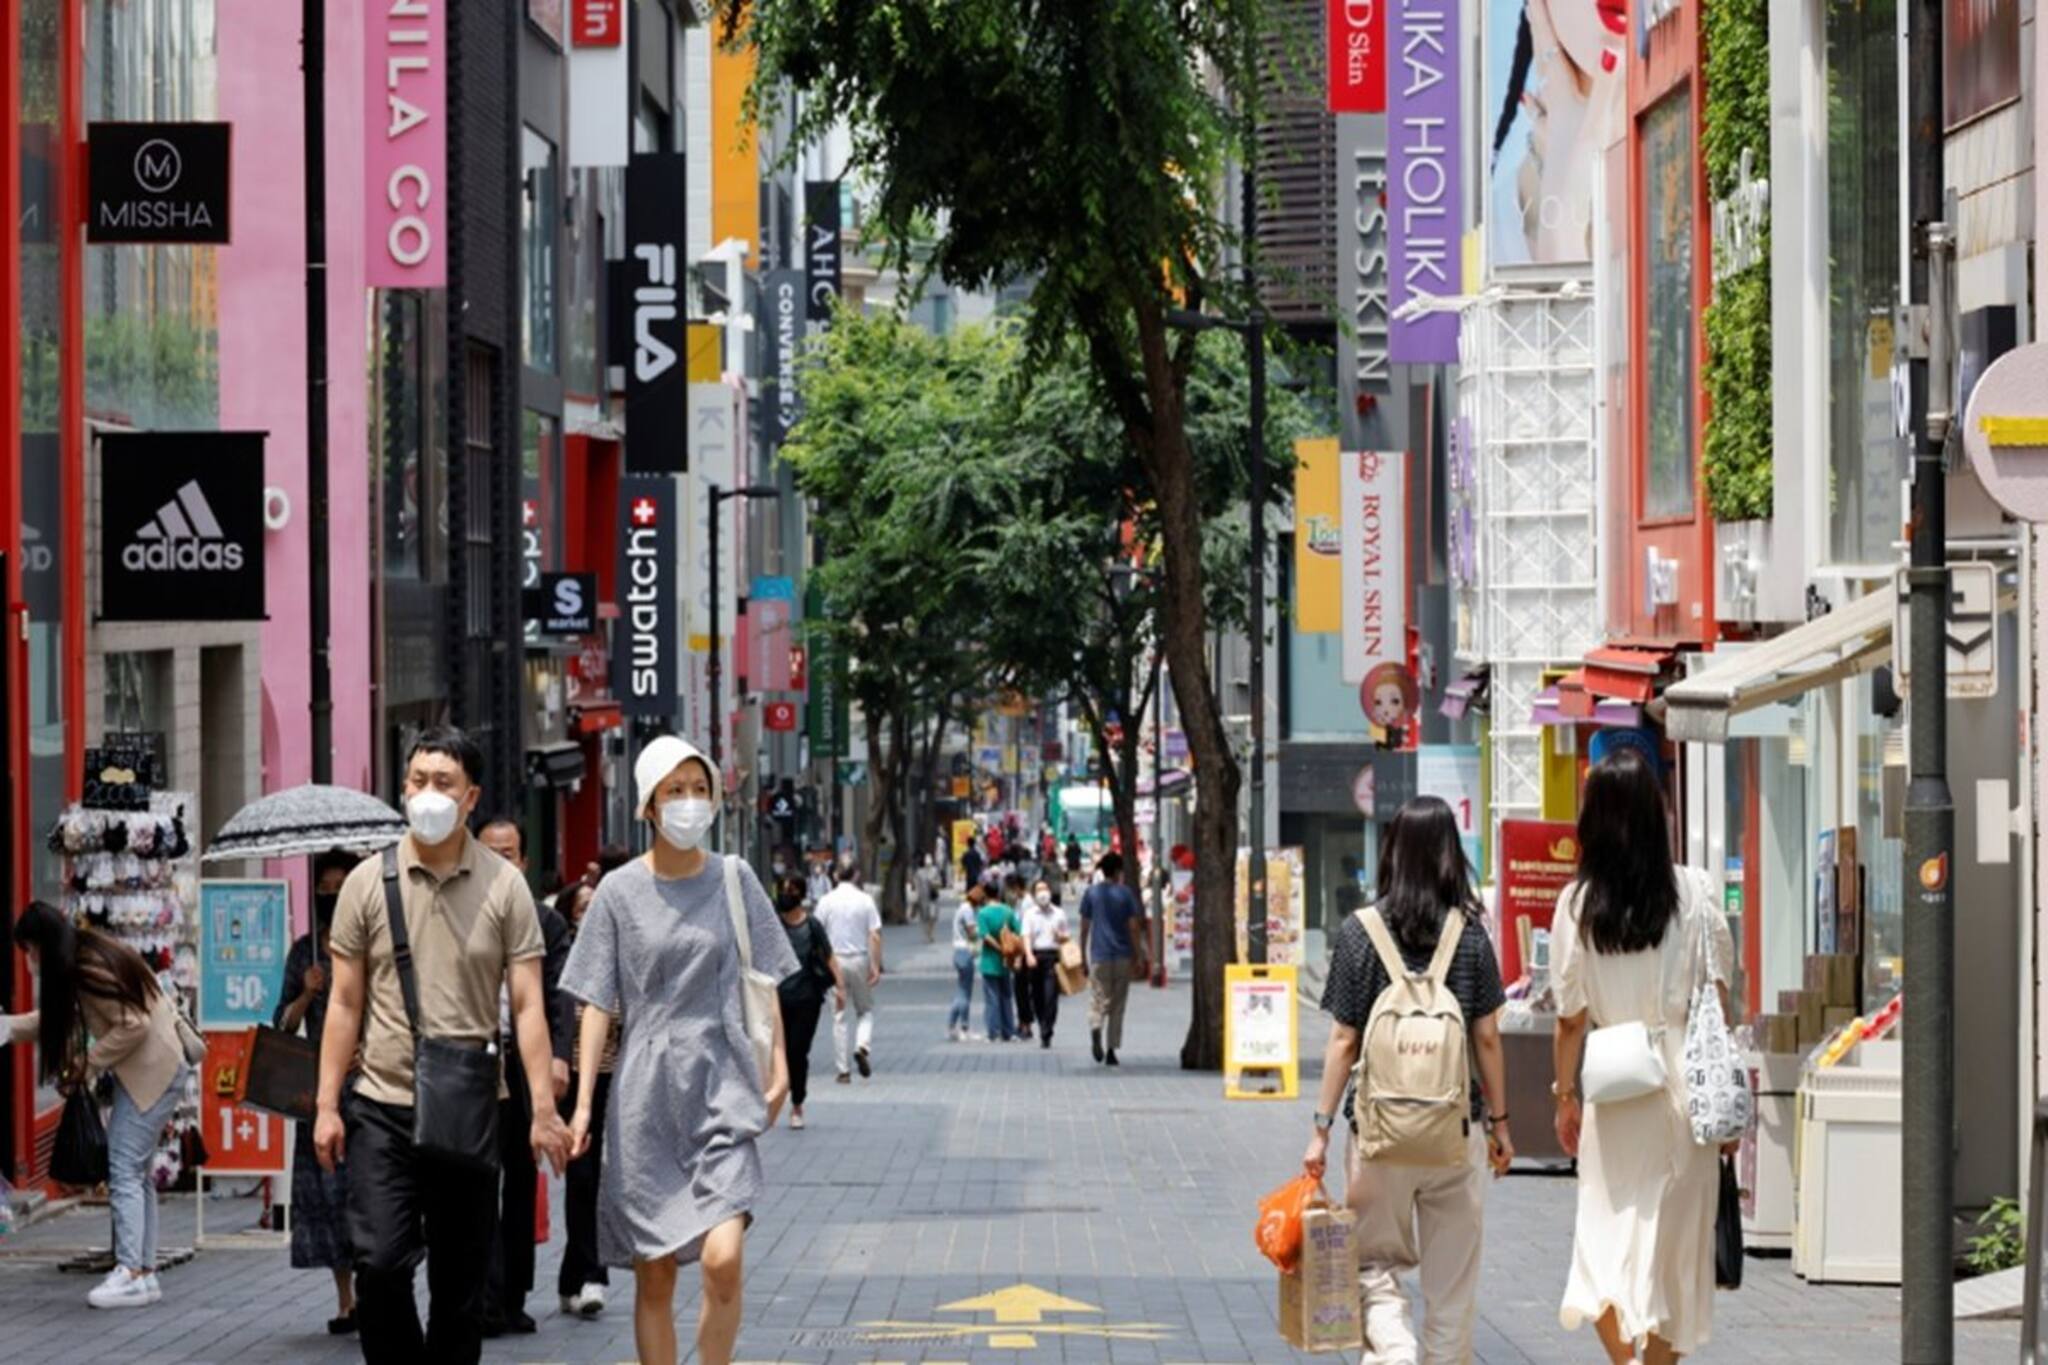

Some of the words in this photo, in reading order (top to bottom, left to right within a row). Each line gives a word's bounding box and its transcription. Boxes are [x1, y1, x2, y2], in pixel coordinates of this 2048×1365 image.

[1348, 32, 1370, 85] Skin
[1402, 0, 1445, 96] IKA
[100, 200, 213, 228] MISSHA
[388, 164, 431, 266] CO
[1403, 117, 1446, 323] HOLIKA
[811, 224, 835, 306] AHC
[635, 244, 676, 383] FILA
[122, 538, 243, 571] adidas
[1363, 494, 1381, 585] ROYAL
[554, 578, 583, 615] S
[626, 528, 658, 696] swatch
[1364, 590, 1382, 656] SKIN
[219, 1107, 270, 1152] 1+1
